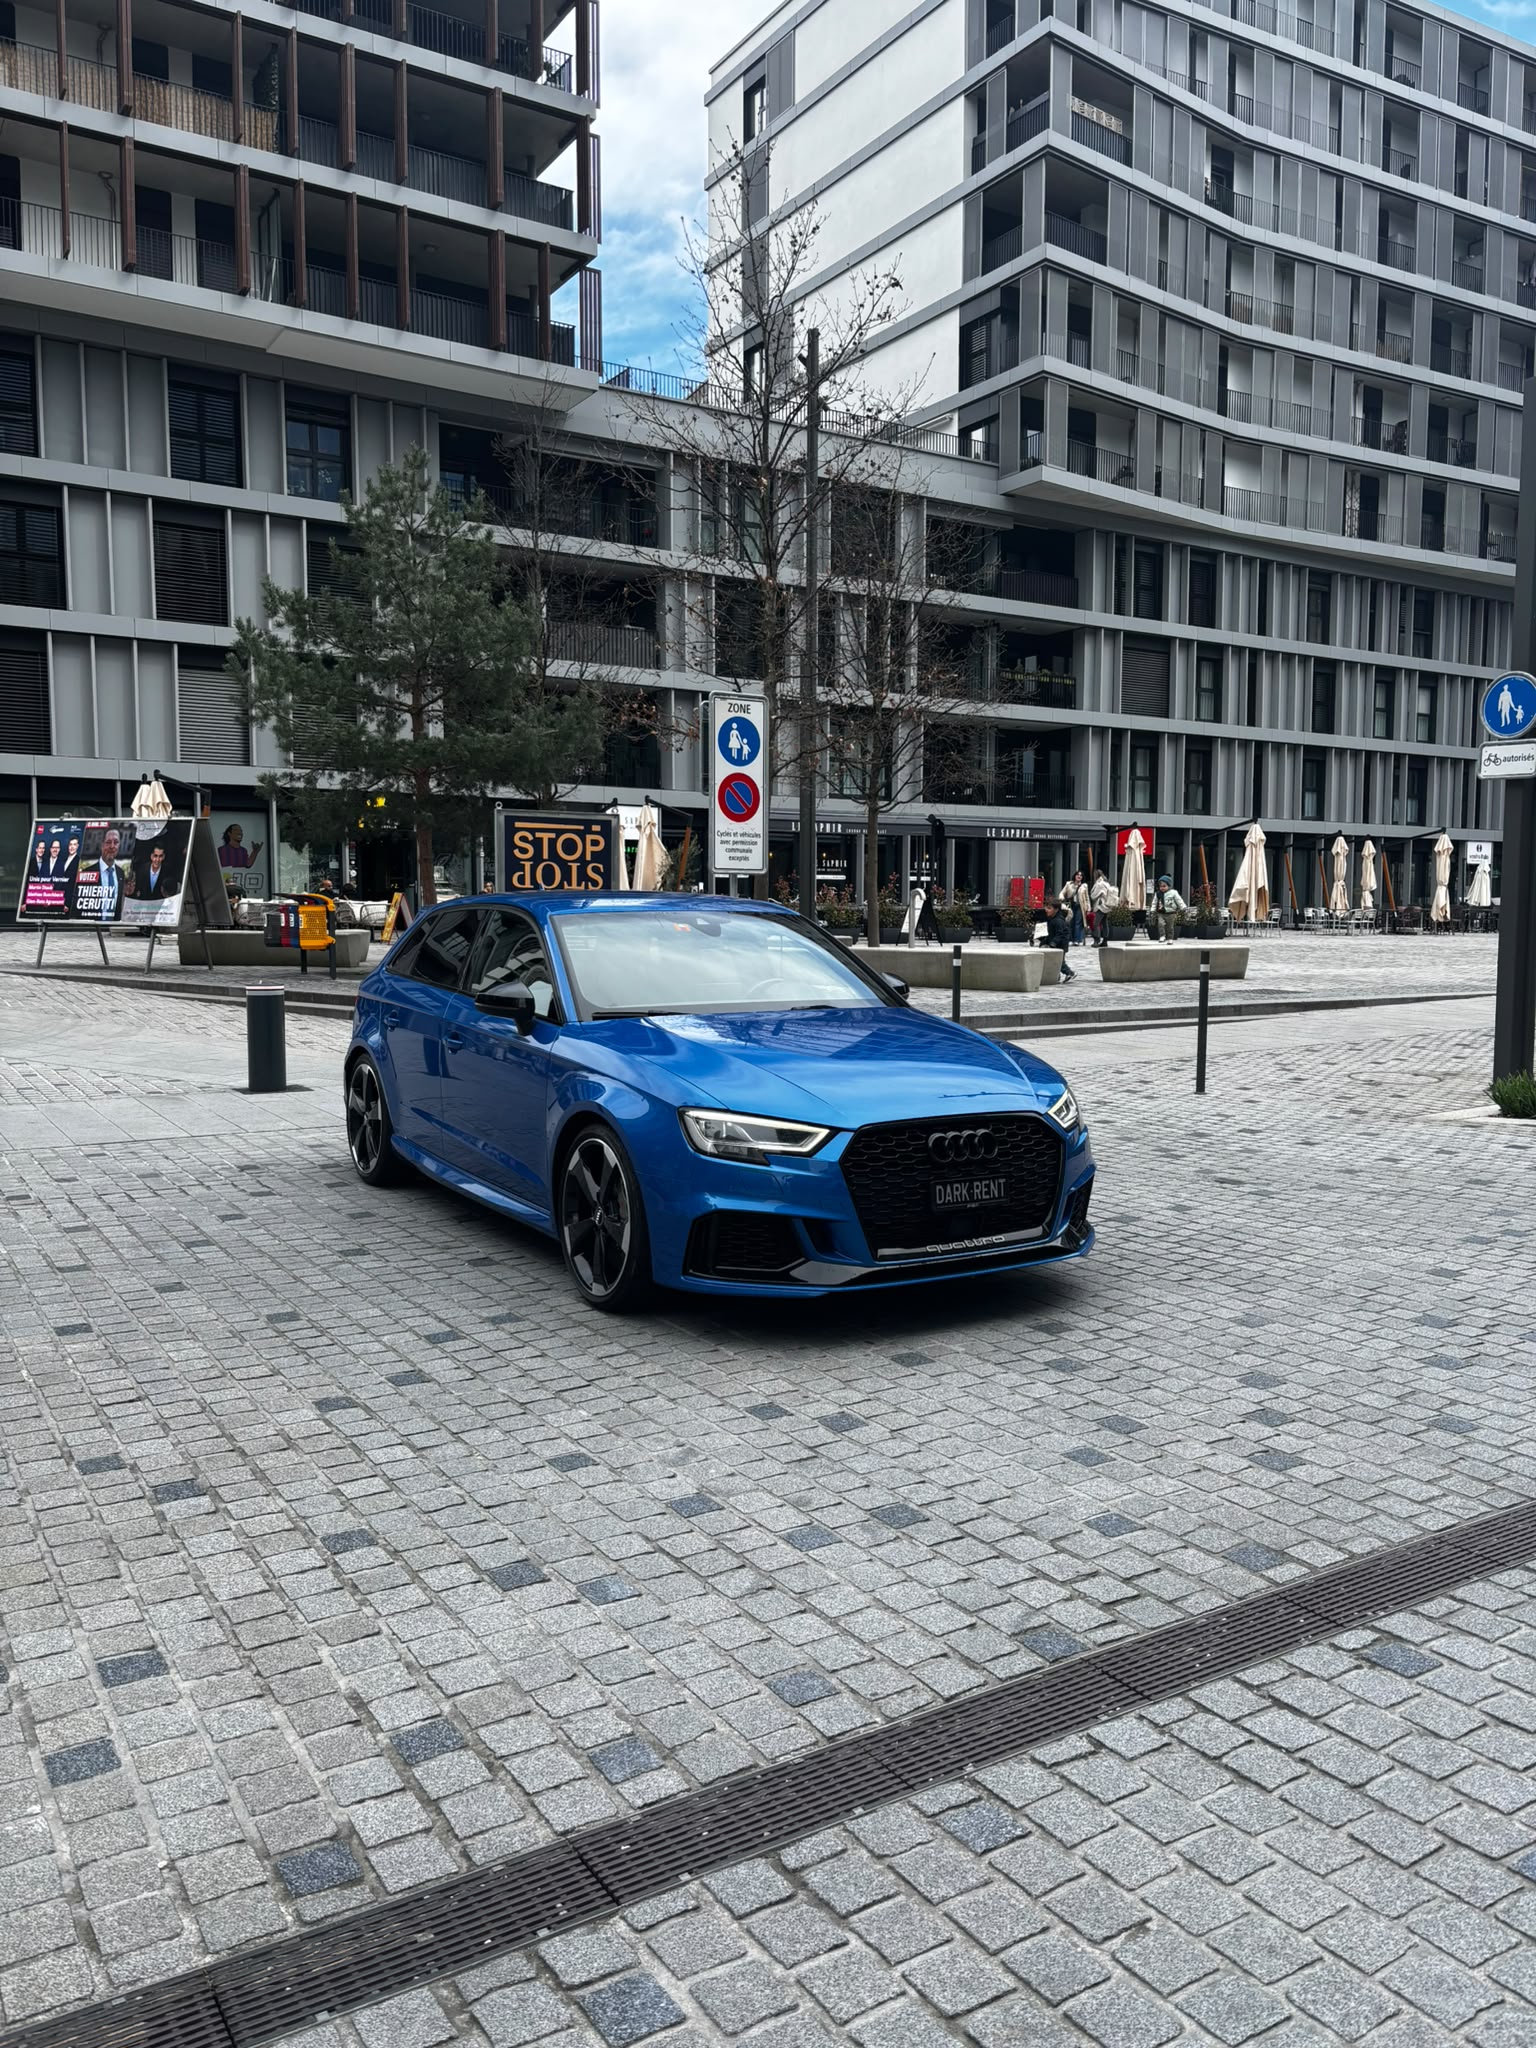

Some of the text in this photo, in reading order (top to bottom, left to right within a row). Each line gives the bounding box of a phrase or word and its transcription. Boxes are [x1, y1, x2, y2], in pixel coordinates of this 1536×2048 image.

[727, 703, 751, 714] ZONE
[1502, 753, 1535, 763] autorisés
[986, 827, 996, 837] LE
[1000, 828, 1030, 838] SAPHIR
[513, 830, 605, 861] STOP
[822, 859, 847, 867] SAPHIR
[79, 872, 97, 881] VOTEZ
[77, 885, 115, 897] THIERRY
[76, 898, 115, 910] CERUTTI
[926, 1235, 1005, 1253] quattro
